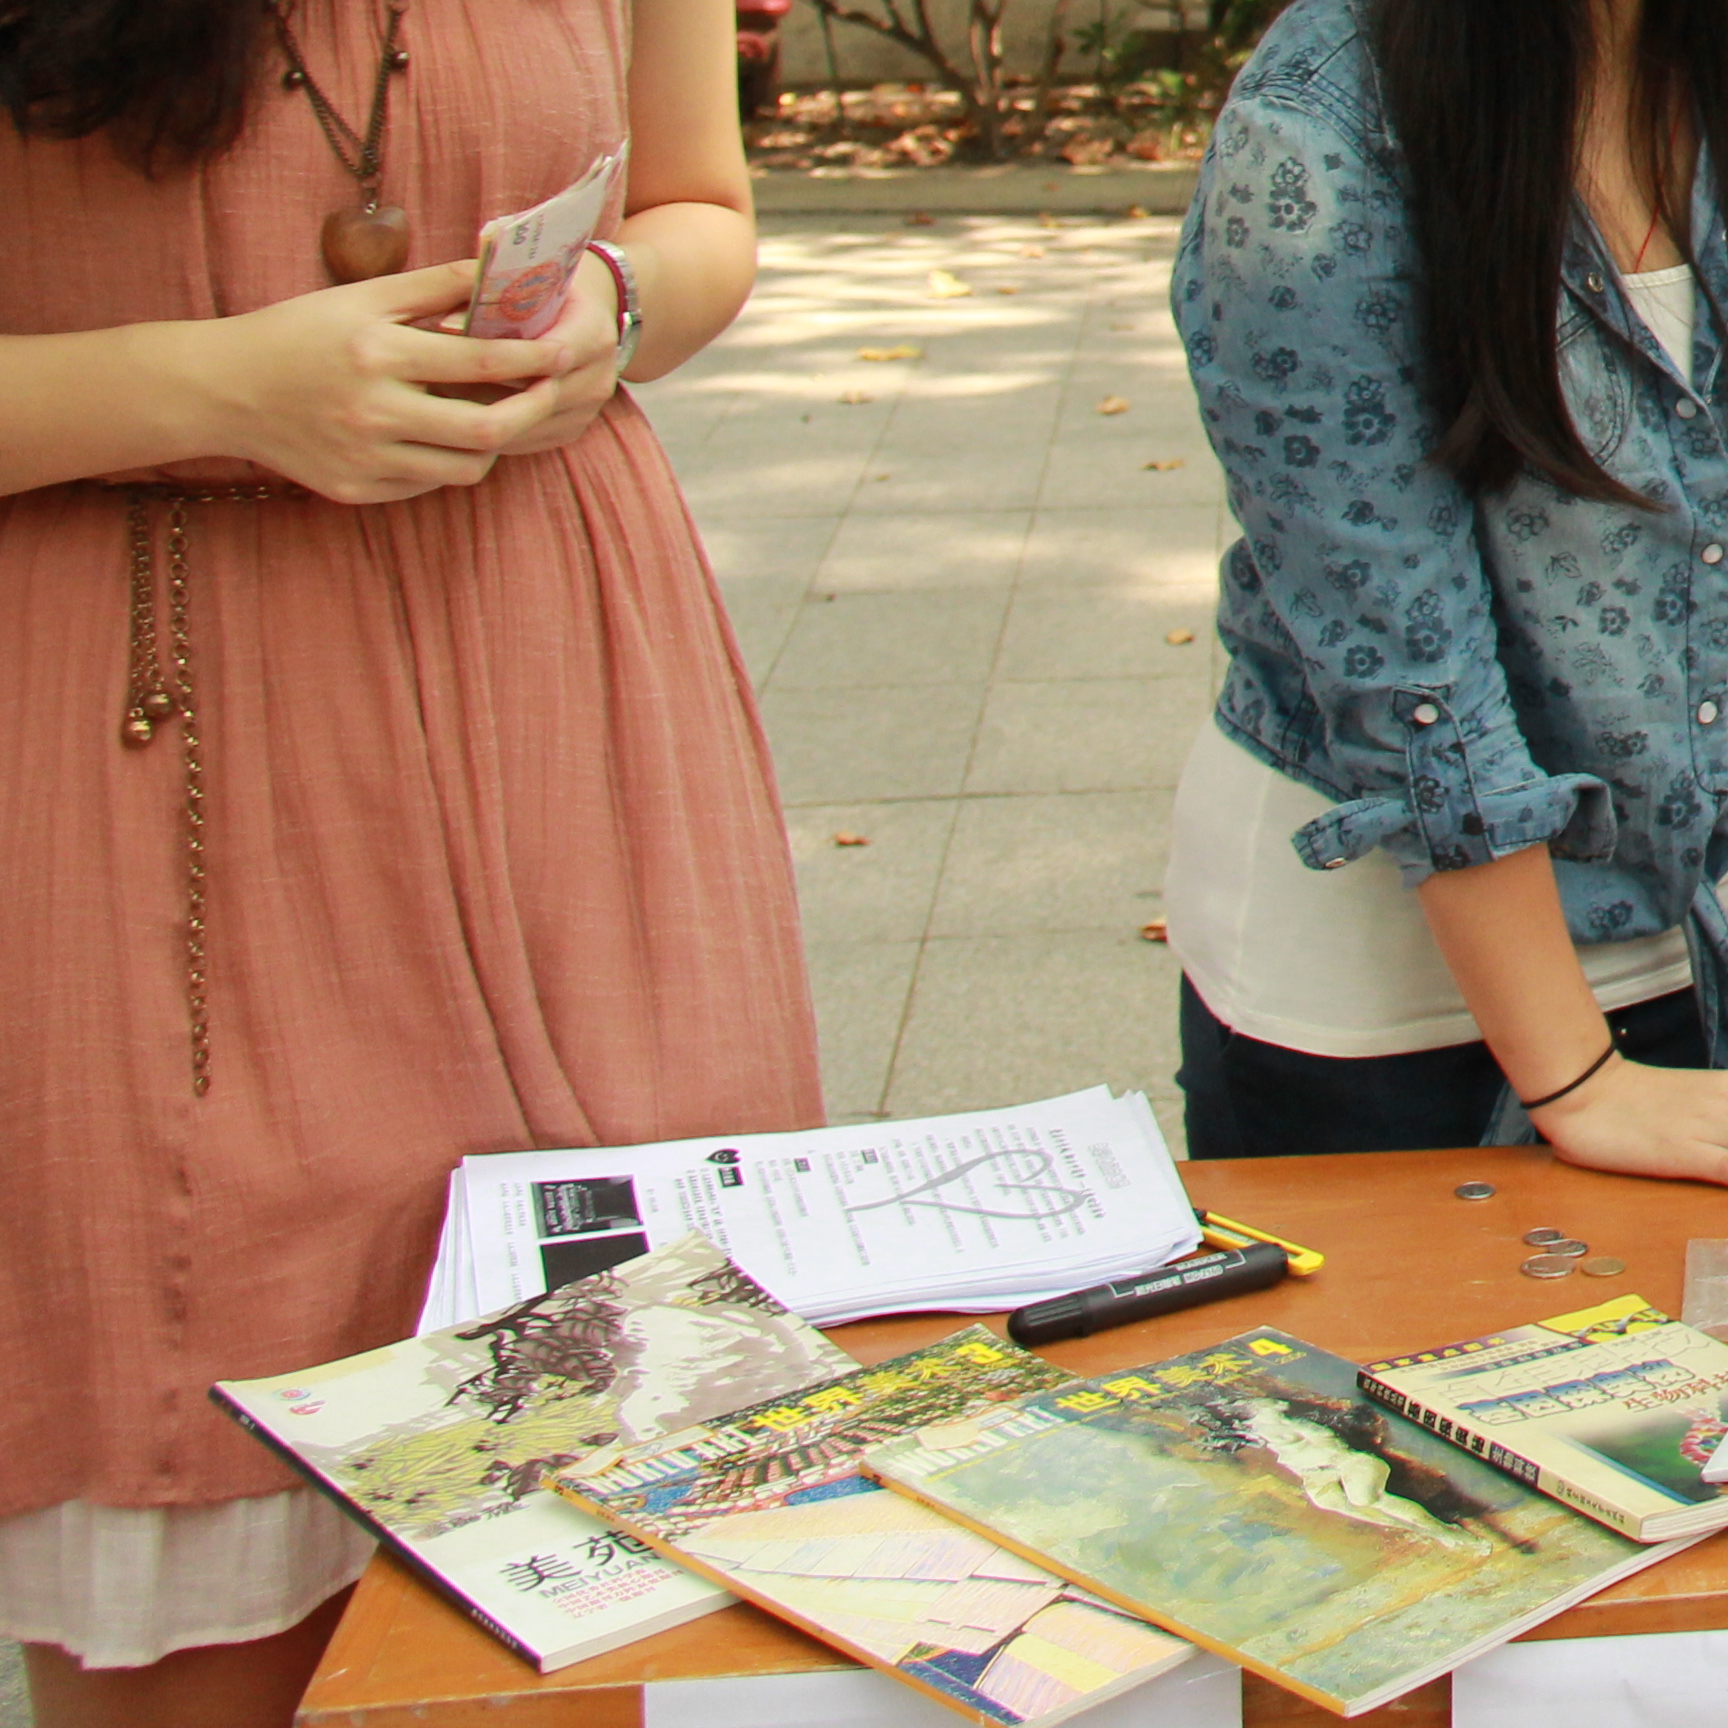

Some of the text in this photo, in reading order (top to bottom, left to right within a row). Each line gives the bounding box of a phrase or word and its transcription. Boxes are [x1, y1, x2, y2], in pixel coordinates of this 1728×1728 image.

[752, 1341, 1005, 1434] 世界美术 3
[1053, 1337, 1293, 1415] 世界美术 4
[499, 1529, 655, 1593] 美苑
[538, 1550, 663, 1599] MEIYUAN
